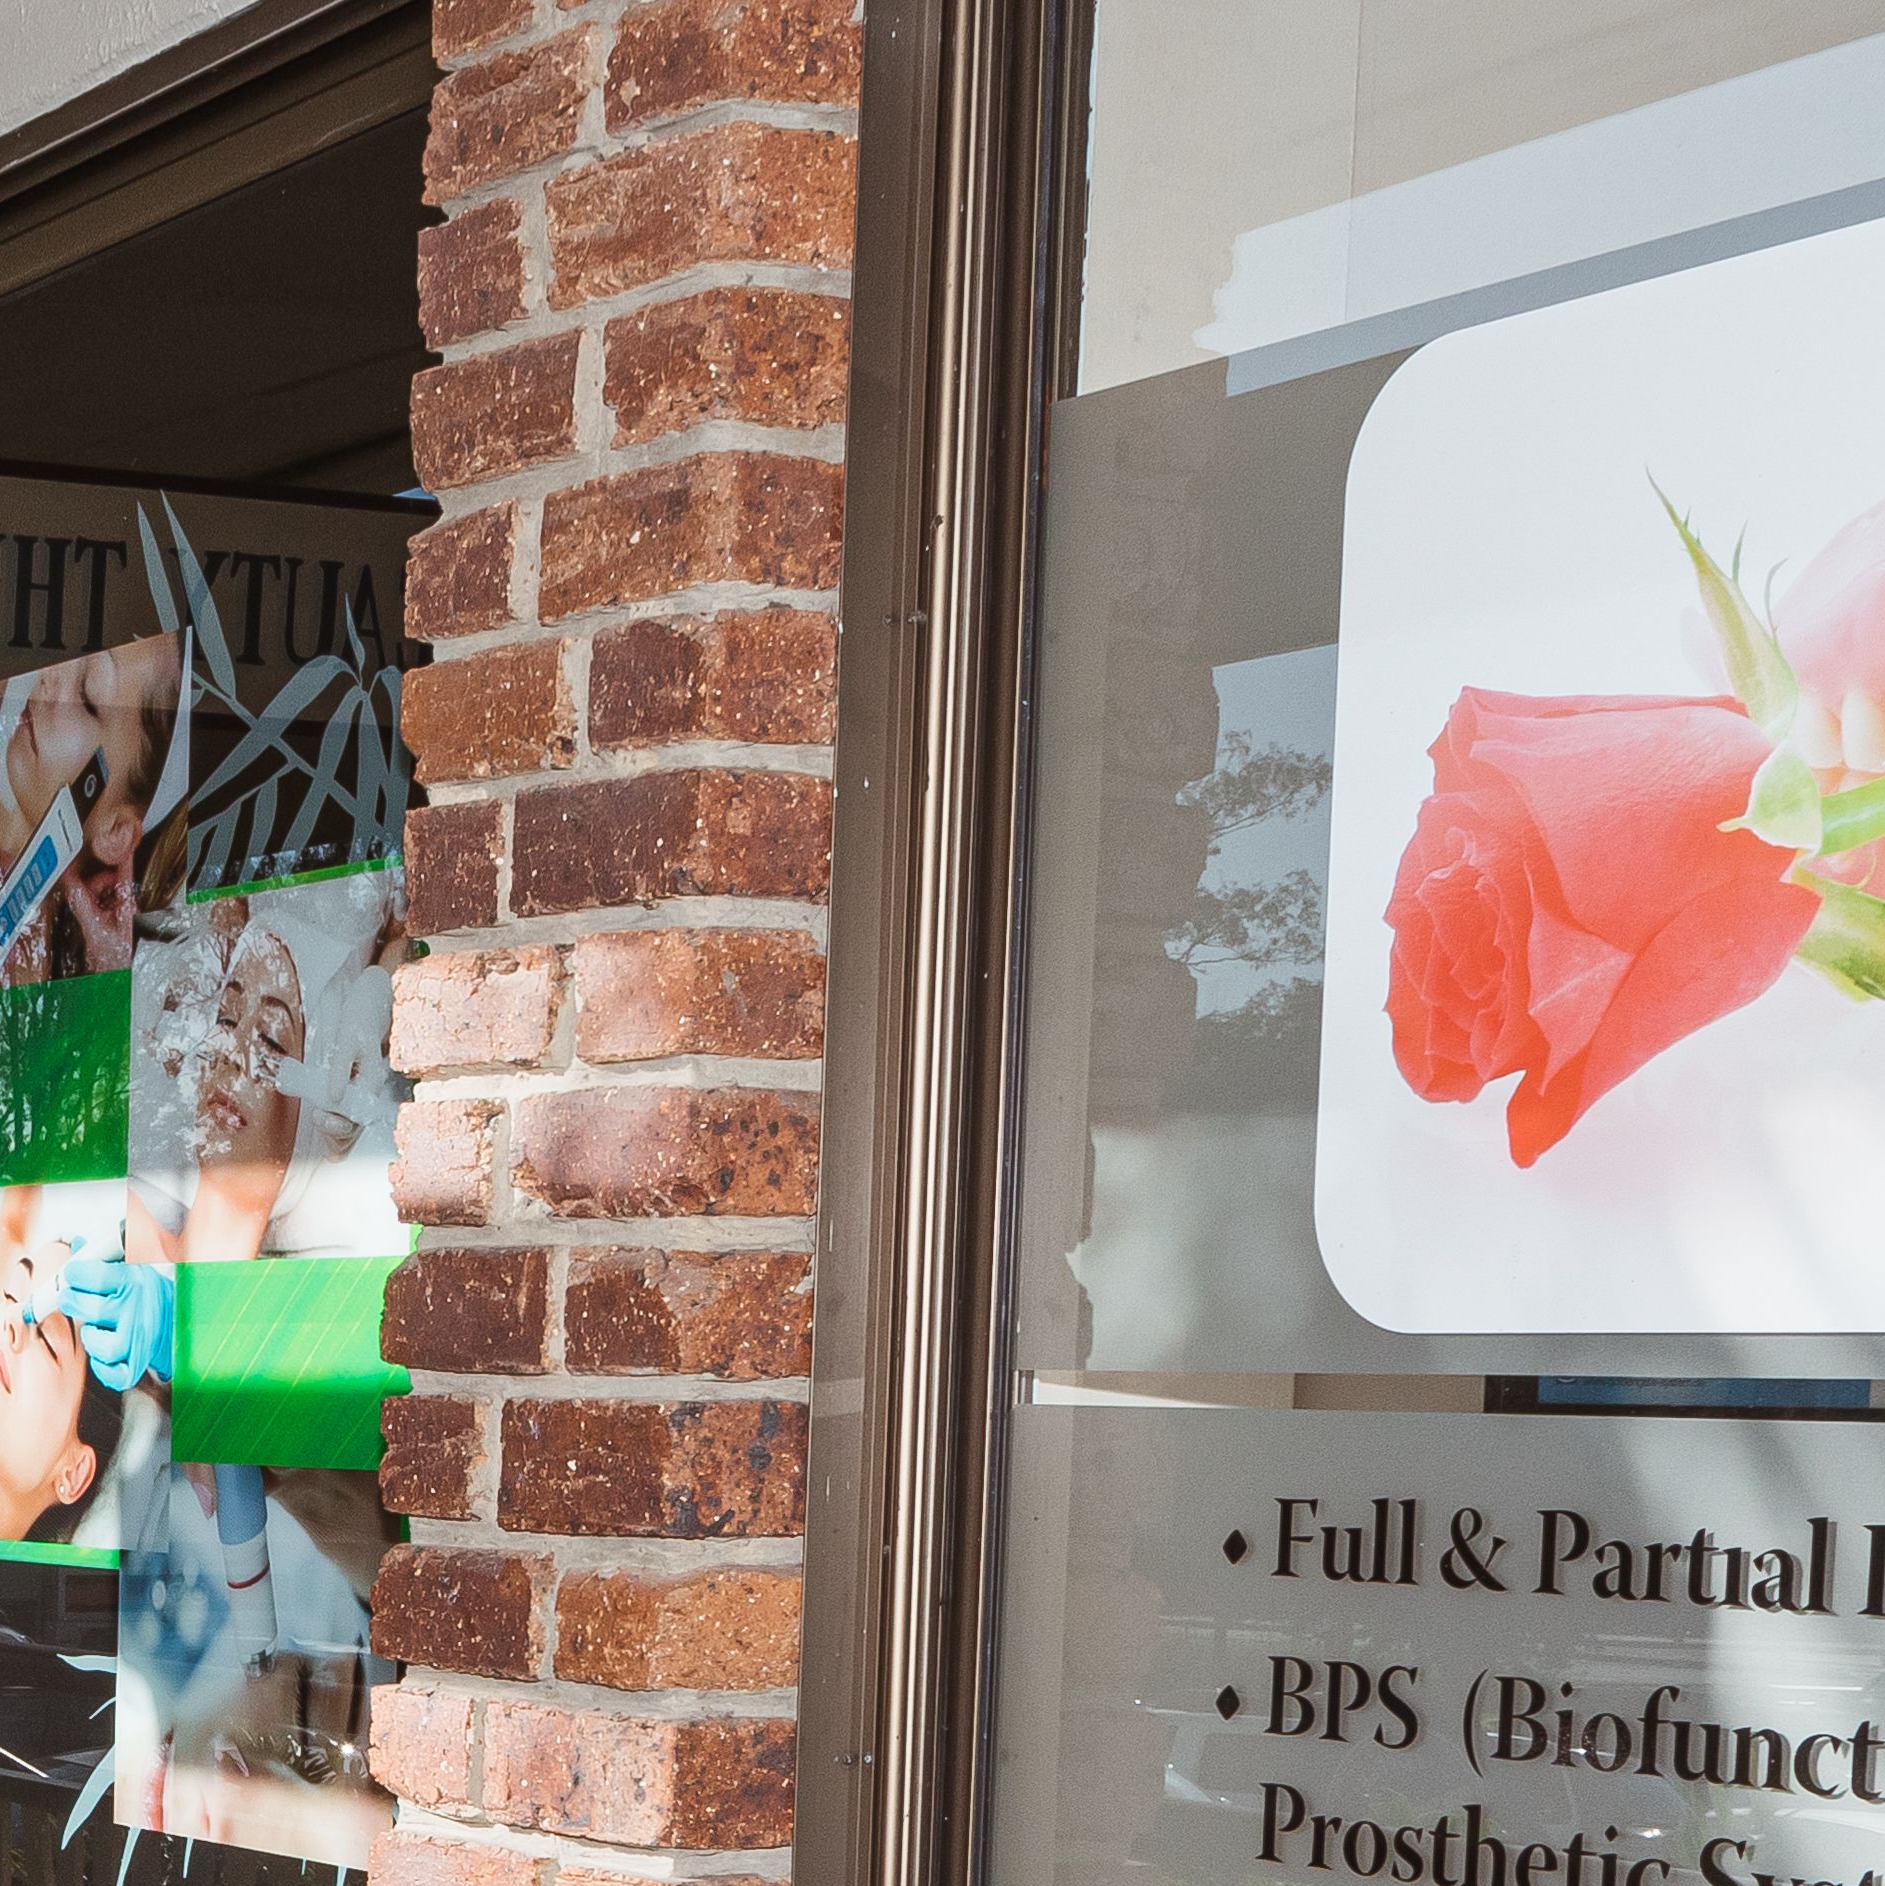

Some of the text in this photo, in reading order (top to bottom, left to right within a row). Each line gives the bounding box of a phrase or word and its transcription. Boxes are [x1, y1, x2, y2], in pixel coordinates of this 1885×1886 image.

[1271, 1497, 1416, 1586] Full
[1440, 1508, 1506, 1590] &
[1535, 1508, 1833, 1613] Partial
[1264, 1655, 1419, 1750] BPS
